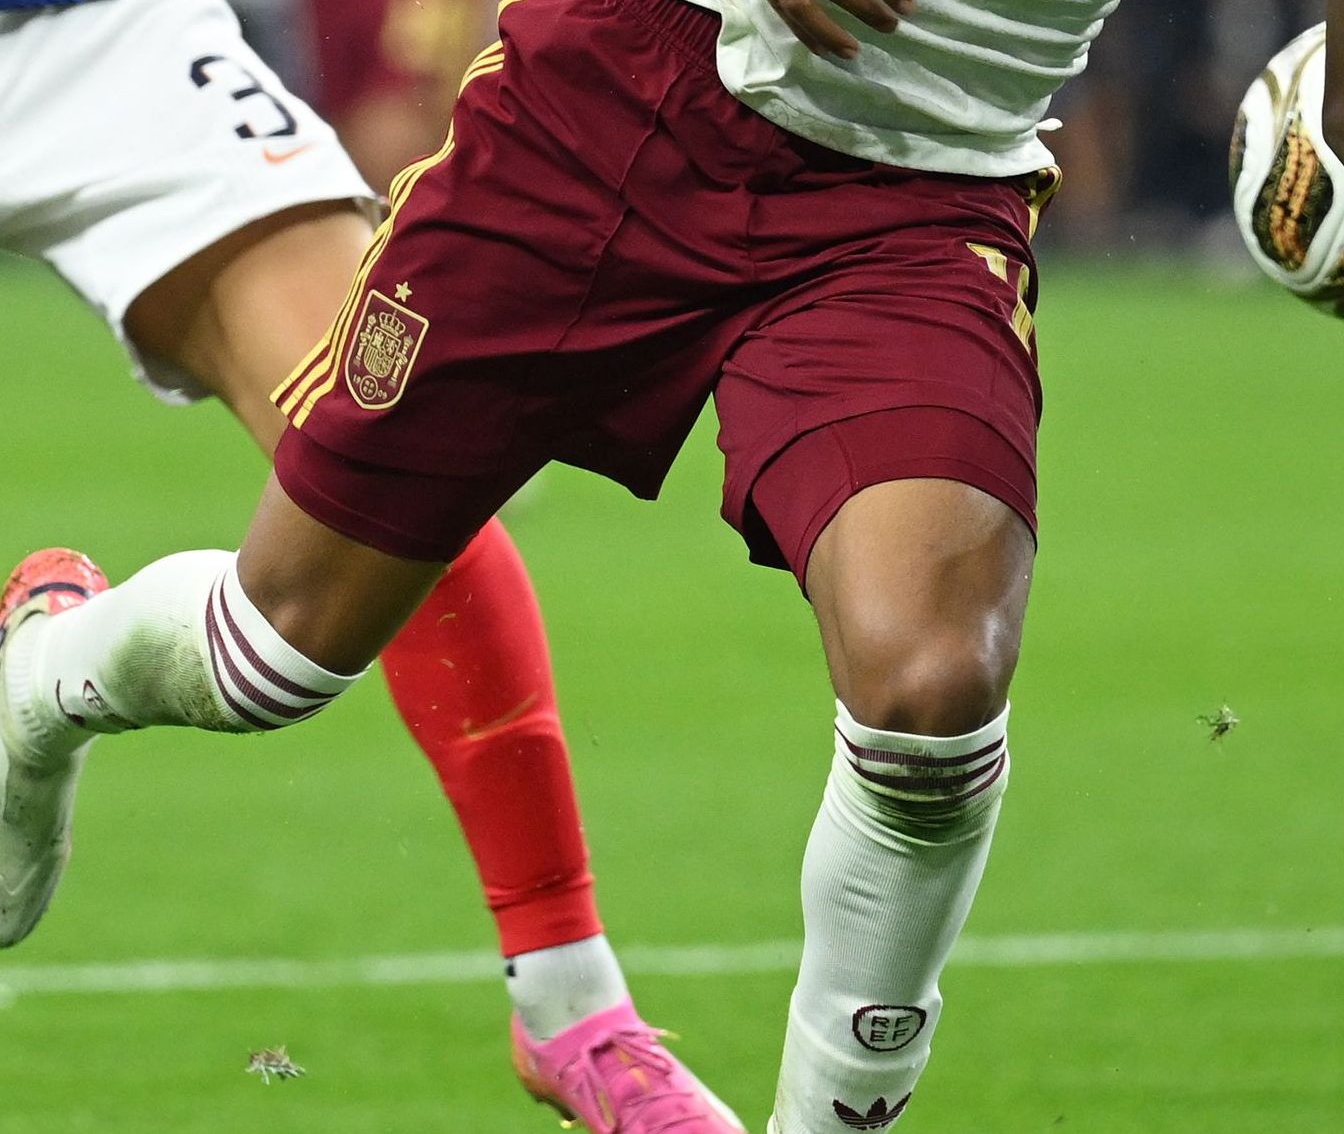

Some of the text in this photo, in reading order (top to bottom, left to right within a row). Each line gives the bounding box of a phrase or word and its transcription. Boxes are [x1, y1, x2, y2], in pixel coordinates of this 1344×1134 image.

[190, 55, 297, 139] 3
[871, 1015, 913, 1028] RF
[869, 1027, 909, 1041] EF
